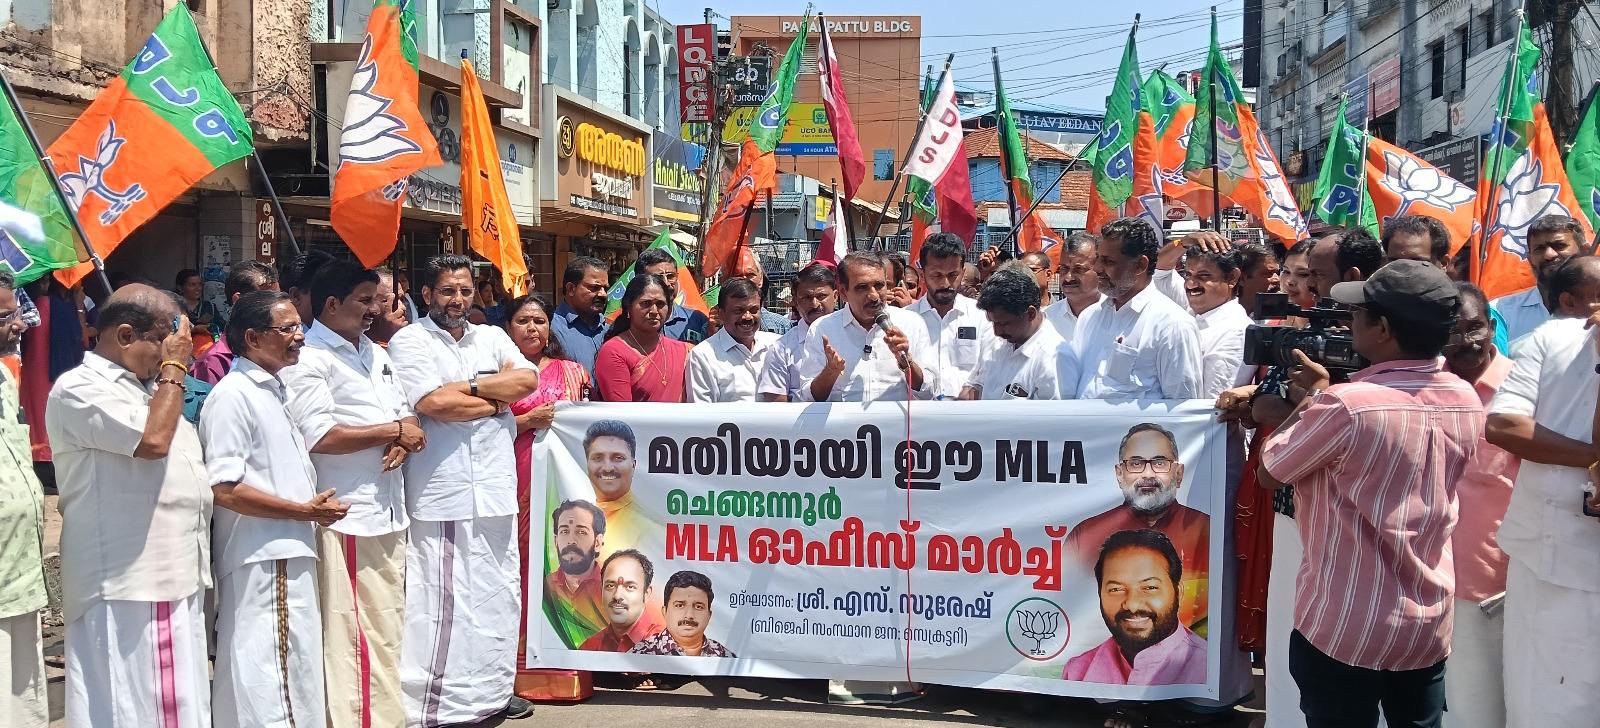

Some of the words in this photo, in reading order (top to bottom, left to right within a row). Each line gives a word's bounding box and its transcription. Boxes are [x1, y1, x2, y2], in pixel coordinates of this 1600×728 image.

[782, 21, 869, 33] PAAPATTU
[873, 20, 914, 33] BLDG.
[655, 156, 679, 188] Anjali
[648, 422, 882, 479] മതിയായി
[894, 439, 983, 491] ഈ
[995, 439, 1088, 485] MLA
[666, 486, 842, 527] ചെങ്ങന്നൂർ
[665, 522, 739, 563] MLA
[748, 516, 921, 571] ഓഫീസ്
[927, 525, 1068, 592] മാർച്ച്
[833, 585, 894, 617] എസ്.
[899, 590, 994, 621] സുരേഷ്
